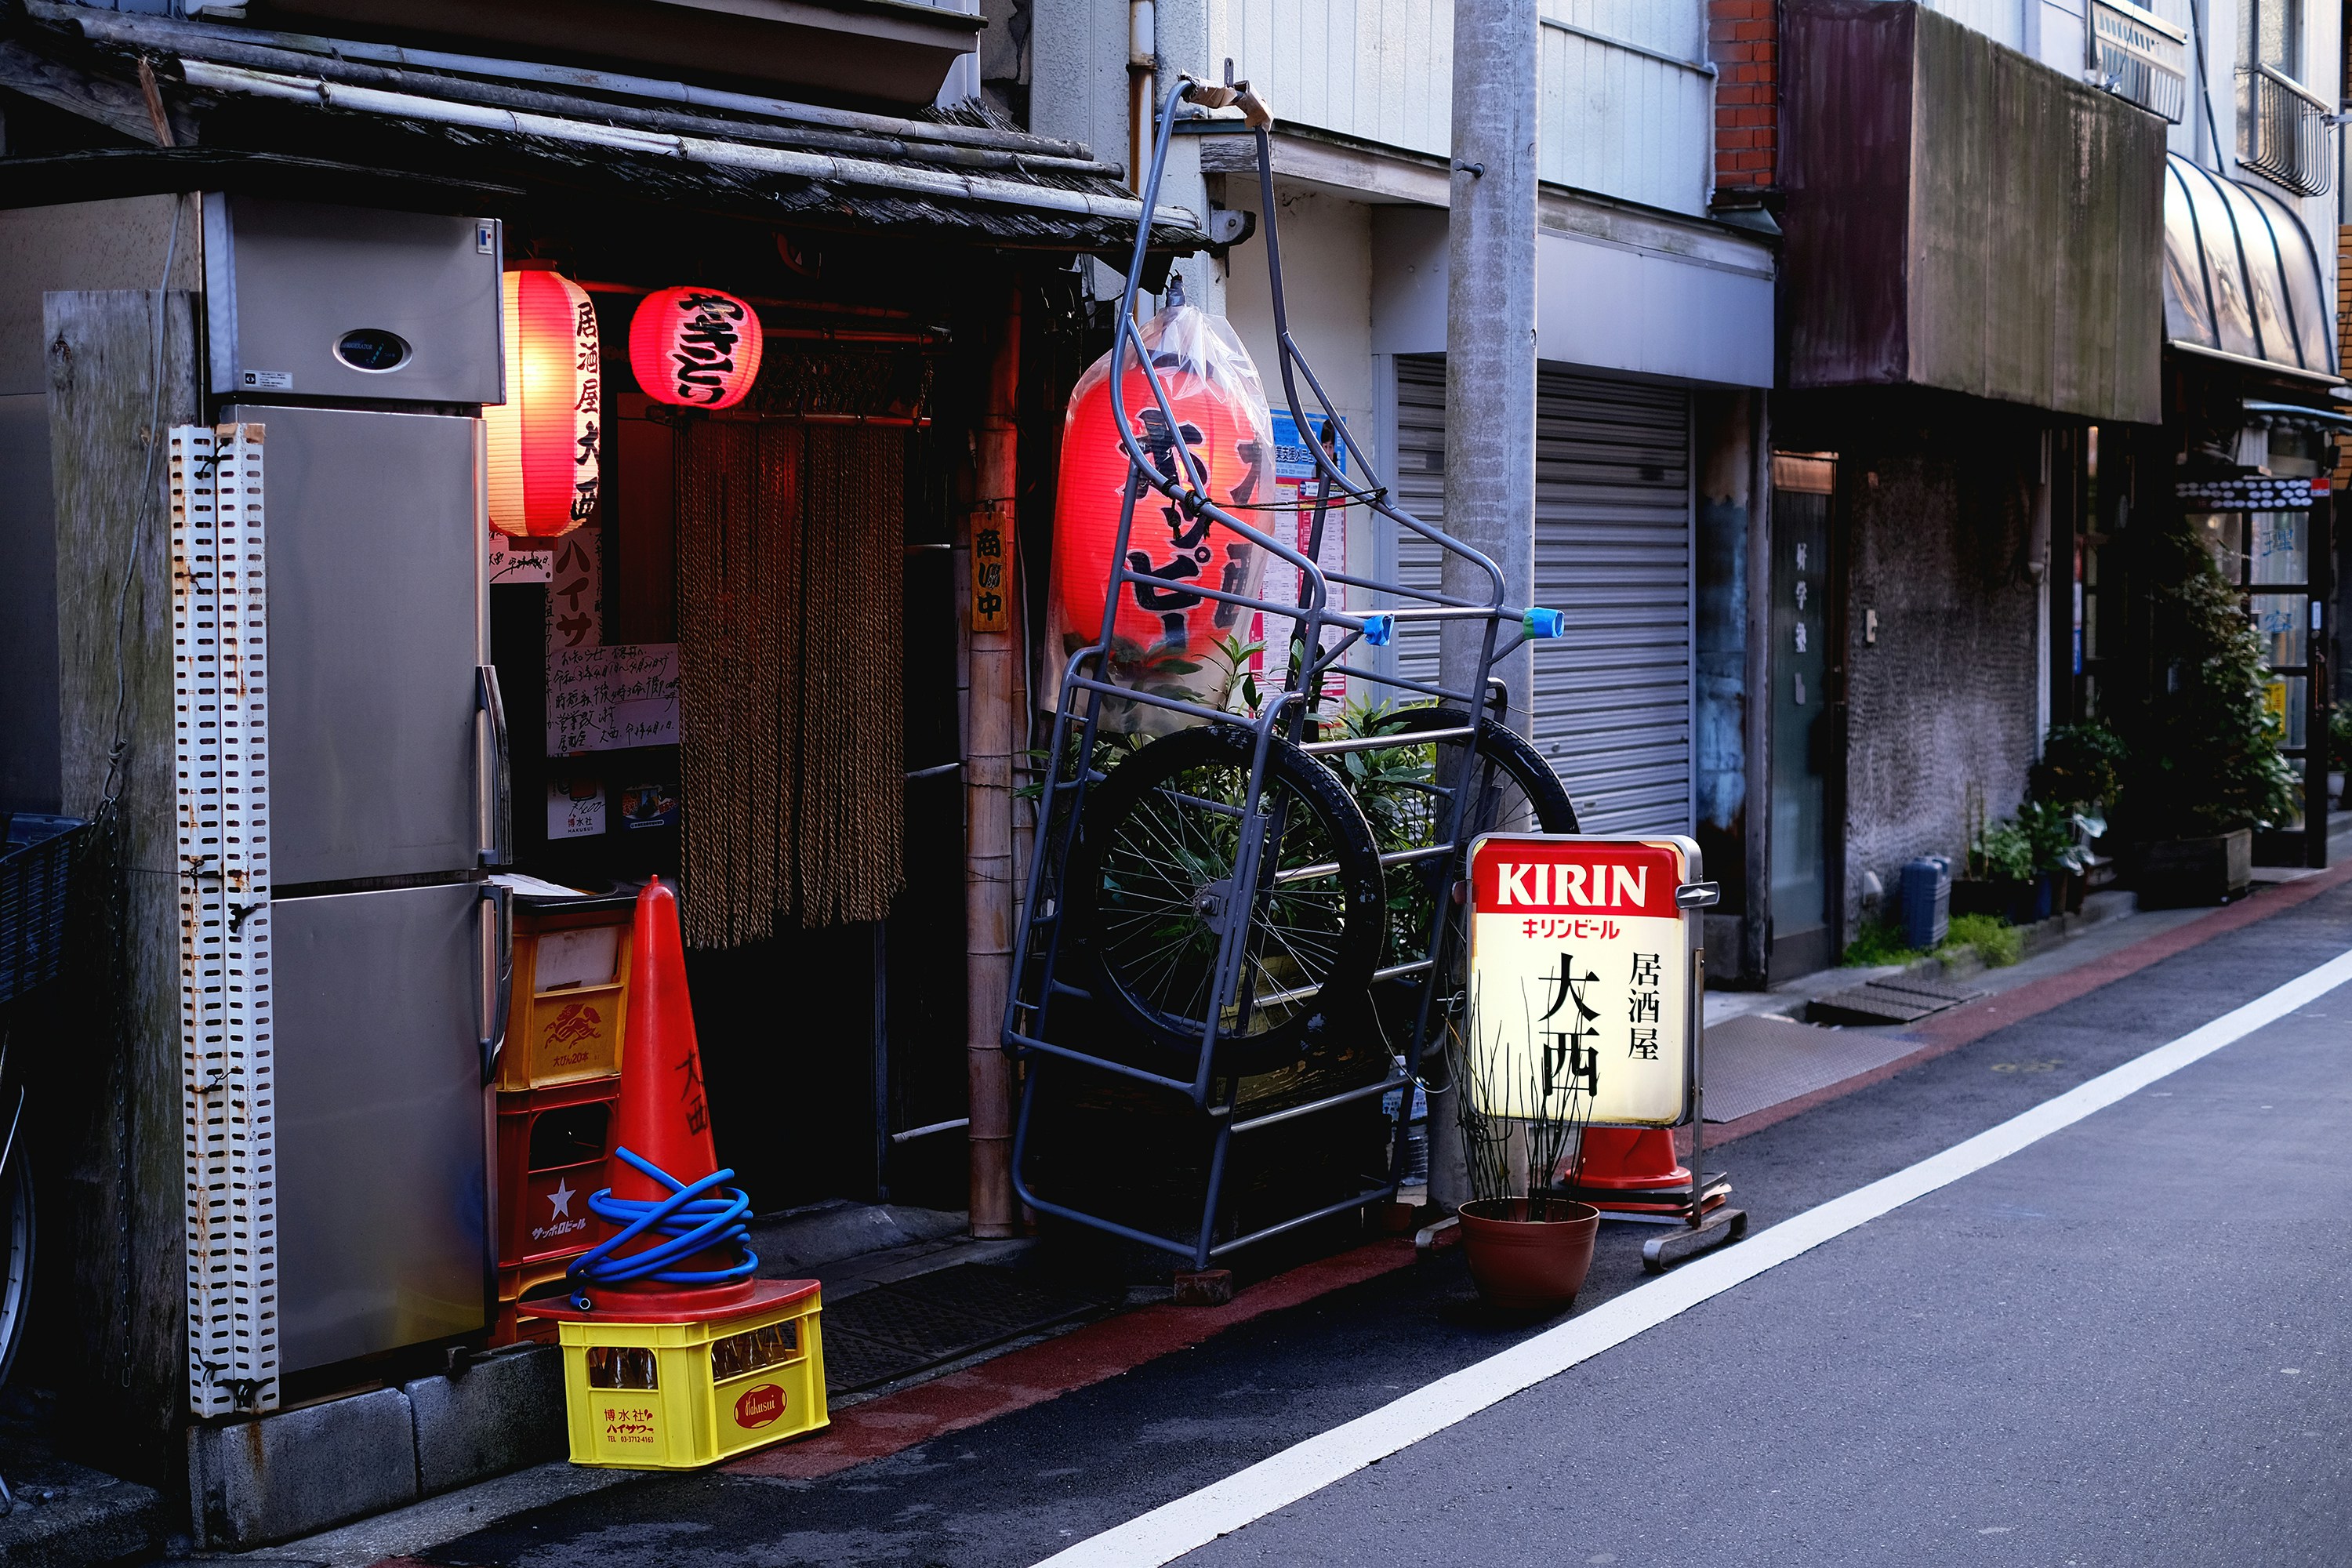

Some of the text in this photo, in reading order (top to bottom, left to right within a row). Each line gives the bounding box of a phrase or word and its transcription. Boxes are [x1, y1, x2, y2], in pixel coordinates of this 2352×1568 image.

[1497, 862, 1648, 908] KIRIN
[1523, 918, 1621, 940] キリンビール
[1628, 951, 1662, 1061] 居酒屋
[1537, 952, 1601, 1098] 大西
[553, 1051, 590, 1068] 大びん20本
[532, 1217, 586, 1241] サッポロビール
[604, 1408, 645, 1422] 博水社
[745, 1393, 776, 1417] Hakusui
[606, 1424, 654, 1434] ハイサワー
